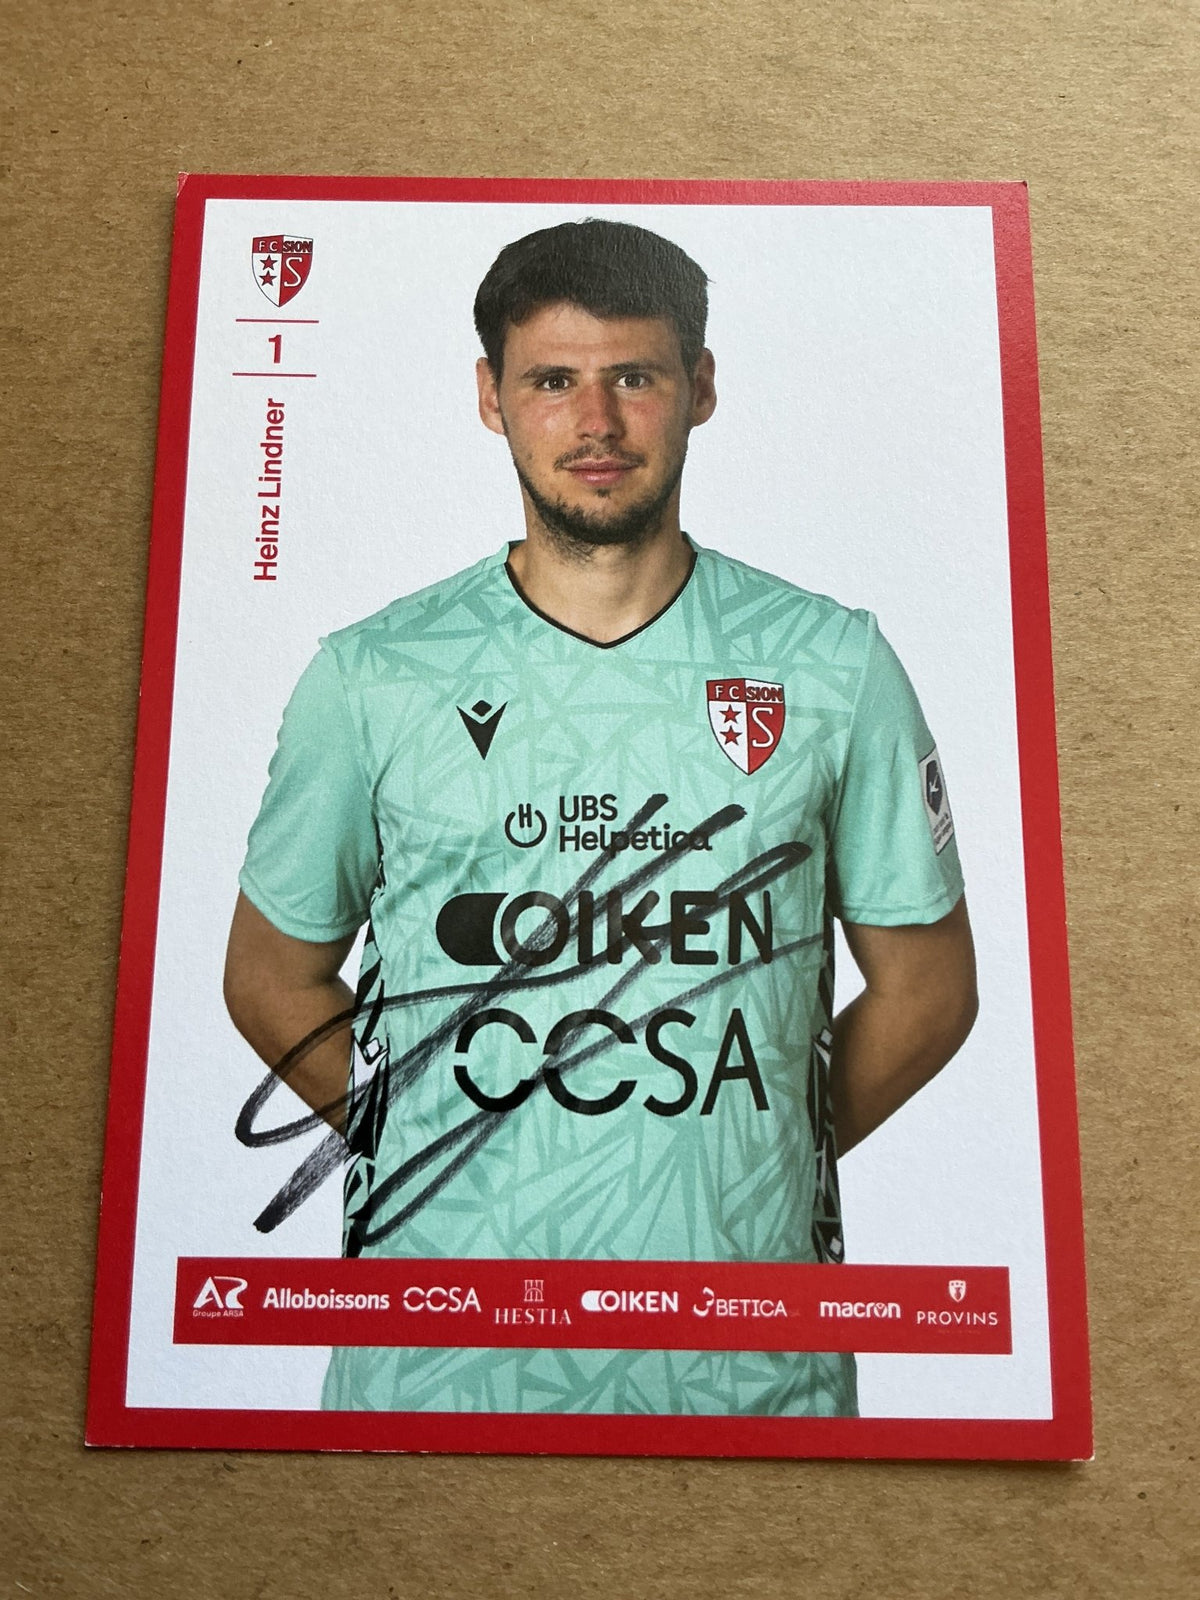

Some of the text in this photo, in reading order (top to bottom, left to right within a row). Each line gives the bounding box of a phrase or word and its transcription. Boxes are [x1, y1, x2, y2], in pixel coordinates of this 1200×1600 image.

[282, 240, 312, 253] SION
[268, 334, 282, 364] 1
[253, 398, 285, 581] Heinz Lindner
[746, 686, 783, 701] SION
[559, 793, 618, 822] UBS
[559, 823, 713, 859] Helpetica
[453, 1007, 770, 1117] CCSA
[262, 1287, 391, 1311] Alloboissons
[402, 1286, 482, 1313] CCSA
[598, 1289, 679, 1314] OIKEN
[715, 1298, 788, 1318] BETICA
[819, 1300, 901, 1319] macron
[192, 1310, 222, 1319] Groupe
[494, 1307, 573, 1325] HESTIA
[916, 1310, 999, 1326] PROVINS
